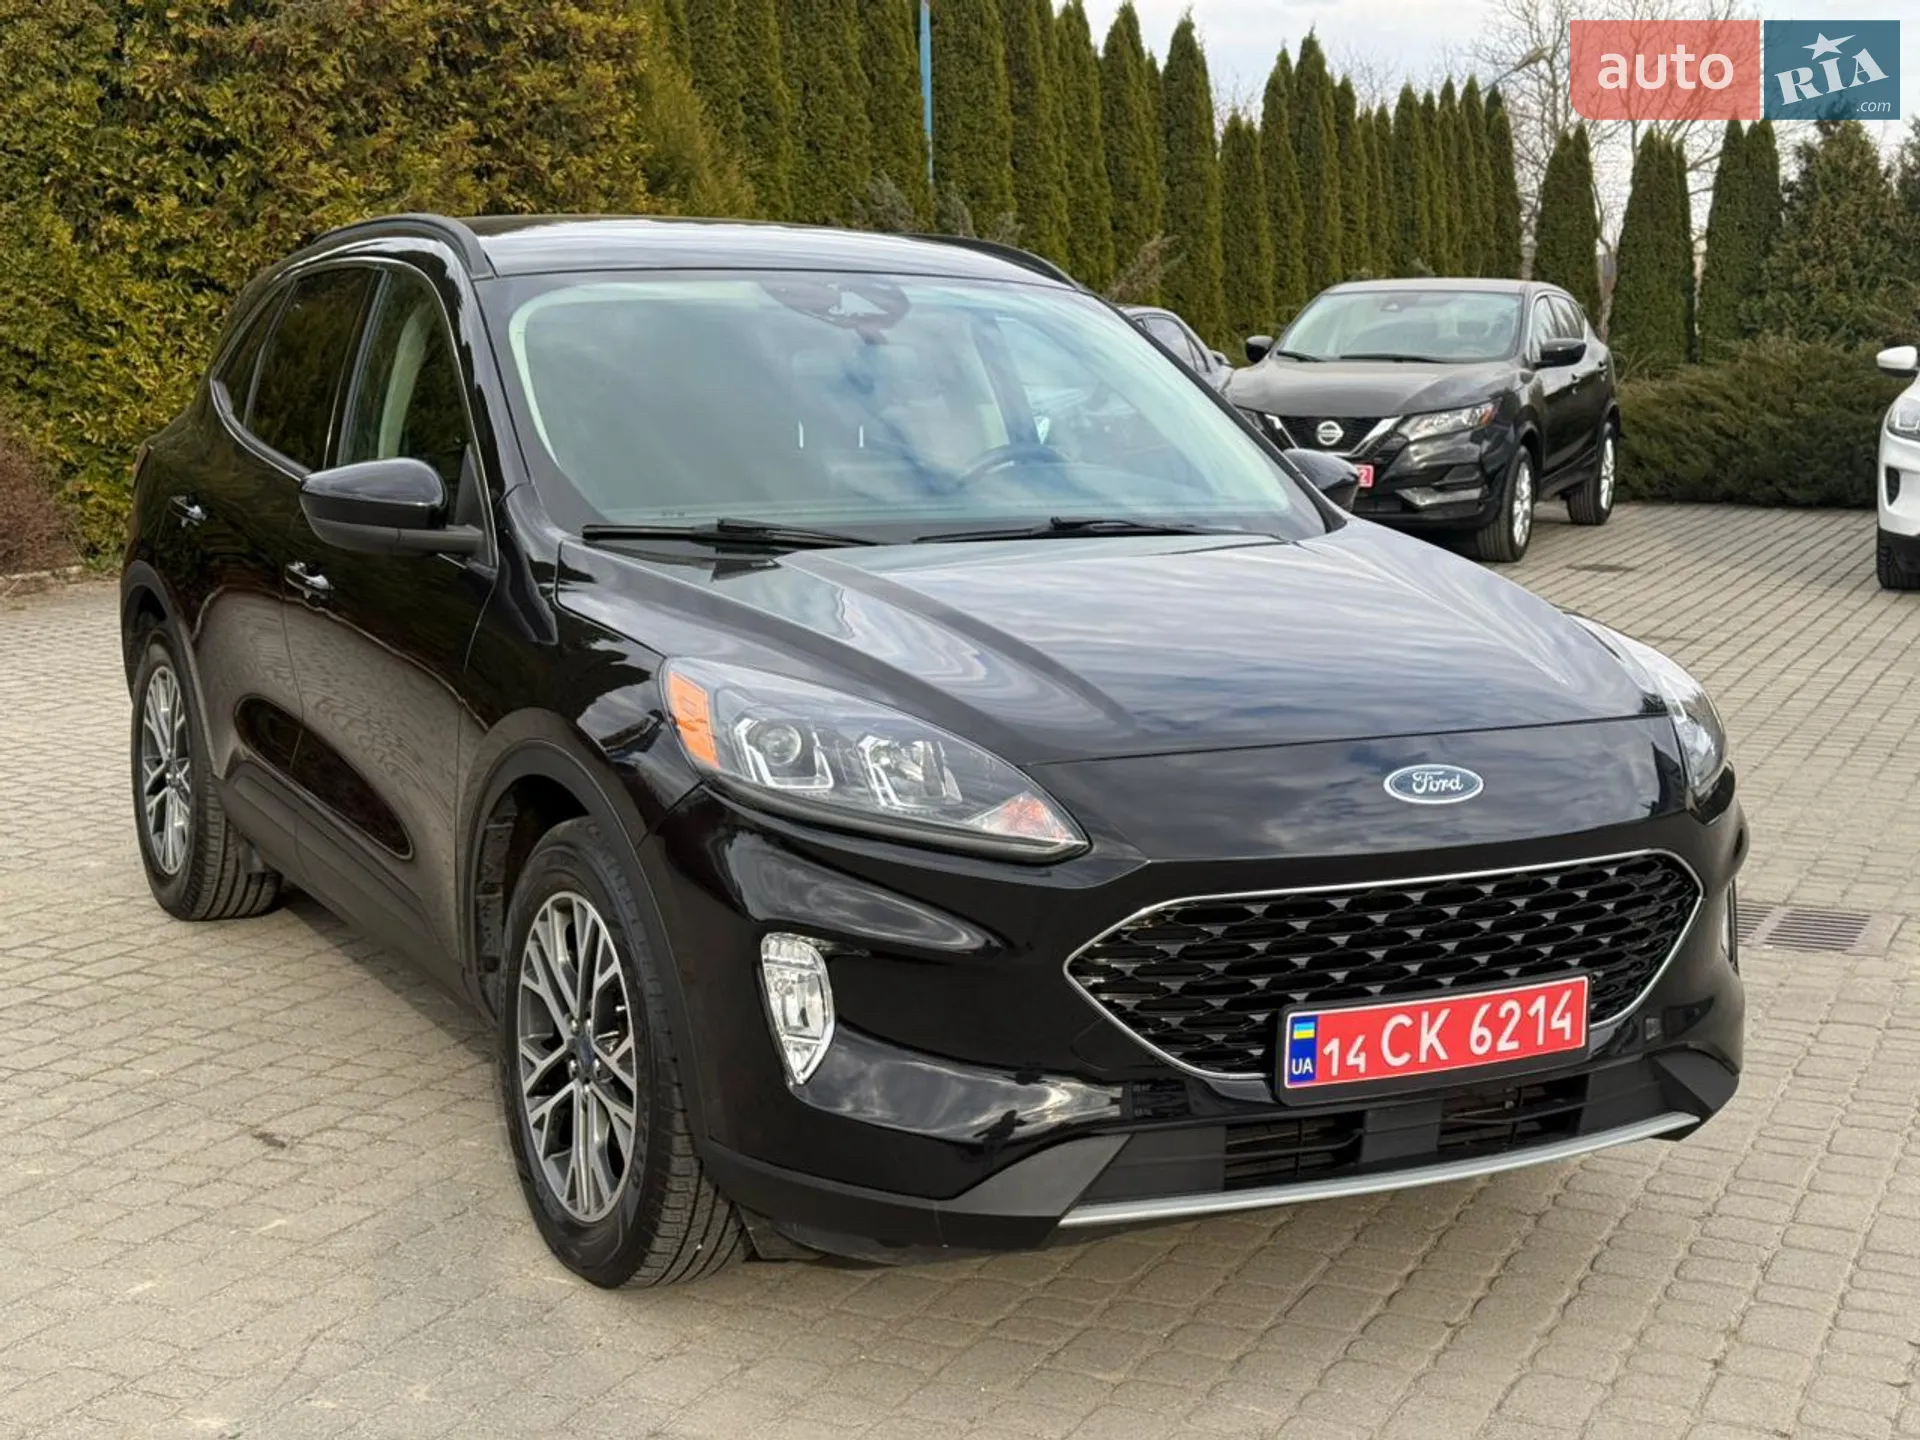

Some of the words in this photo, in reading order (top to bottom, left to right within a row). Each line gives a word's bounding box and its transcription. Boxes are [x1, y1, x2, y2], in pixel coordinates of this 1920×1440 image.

[1411, 770, 1464, 794] Ford
[1322, 1034, 1367, 1077] 14
[1380, 1008, 1450, 1067] CK
[1469, 989, 1573, 1056] 6214
[1291, 1056, 1314, 1075] UA
